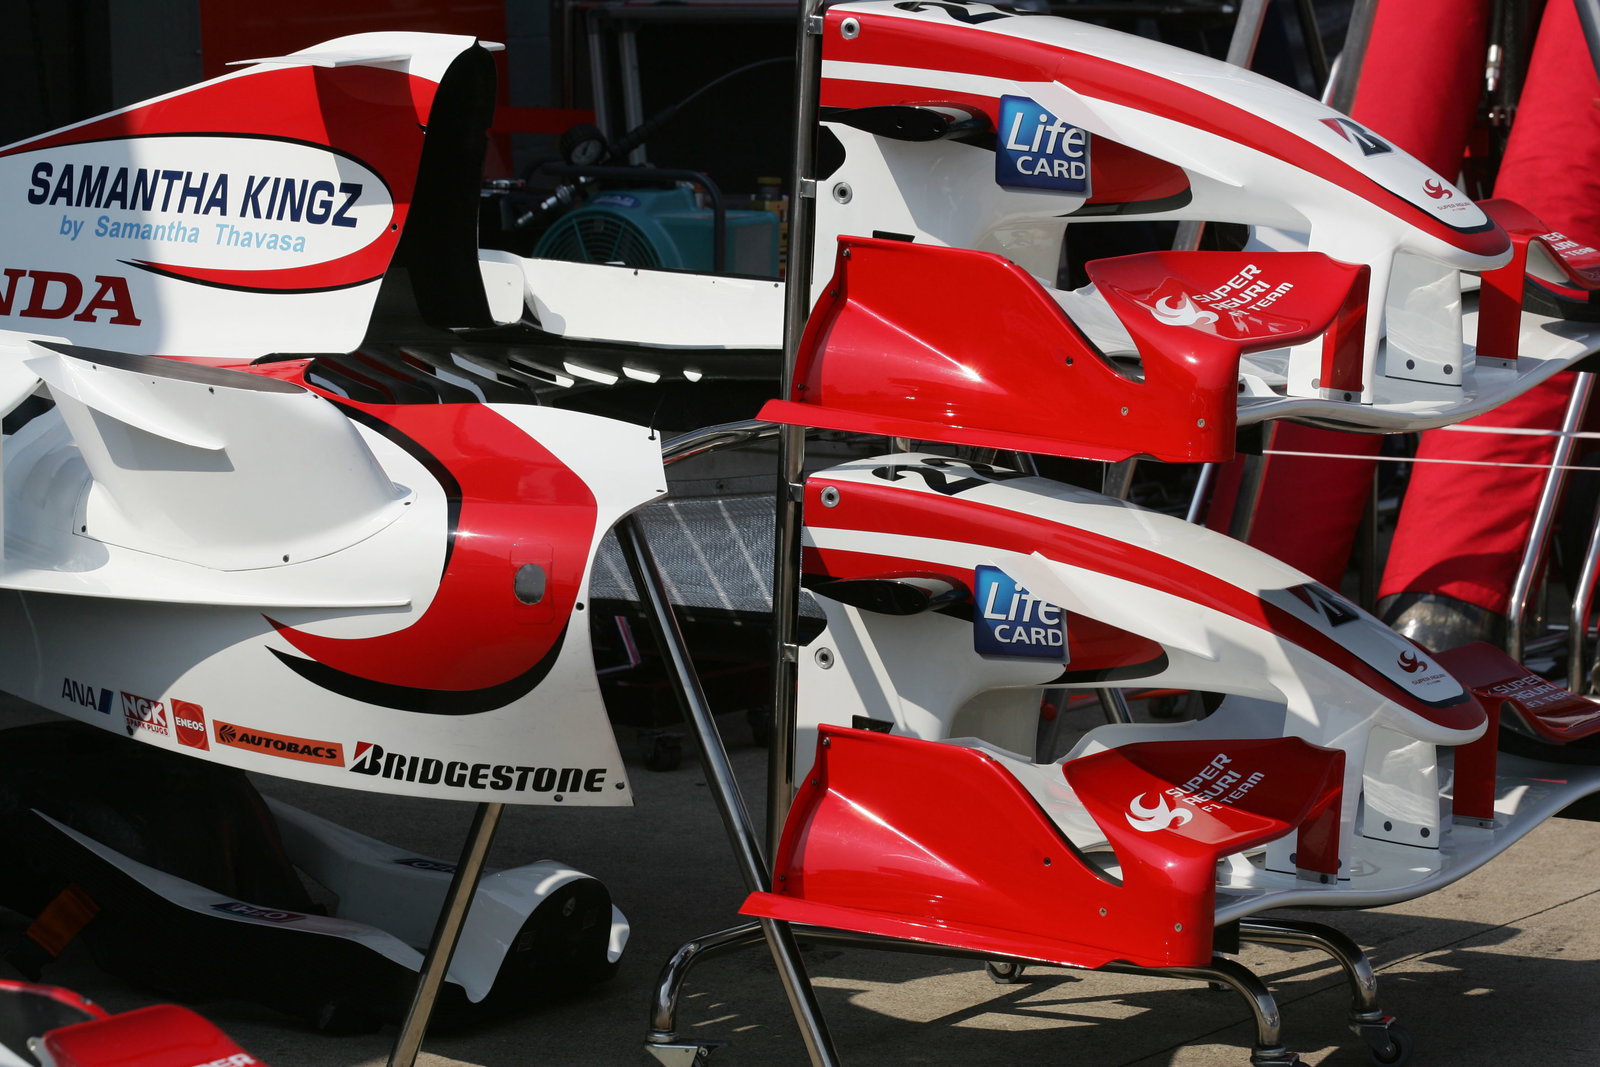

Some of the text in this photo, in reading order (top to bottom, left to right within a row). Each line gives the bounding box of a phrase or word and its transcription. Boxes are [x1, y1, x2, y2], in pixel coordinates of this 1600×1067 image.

[1006, 111, 1086, 158] Life
[1016, 155, 1086, 180] CARD
[27, 161, 364, 228] SAMANTHA KINGZ
[60, 214, 307, 253] by Samantha Thavasa
[1192, 263, 1262, 303] SUPER
[1208, 280, 1272, 311] AGURI
[1247, 282, 1294, 311] TEAM
[994, 624, 1064, 647] CARD
[61, 677, 98, 711] ANA
[121, 692, 167, 727] NGK
[126, 717, 169, 736] SPARK PLUGS
[175, 716, 206, 732] ENEOS
[238, 733, 338, 760] AUTOBACS
[348, 741, 608, 793] BRIDGESTONE
[1164, 753, 1233, 798] SUPER
[1182, 769, 1243, 806] AGURI
[1201, 771, 1265, 813] F1 TEAM
